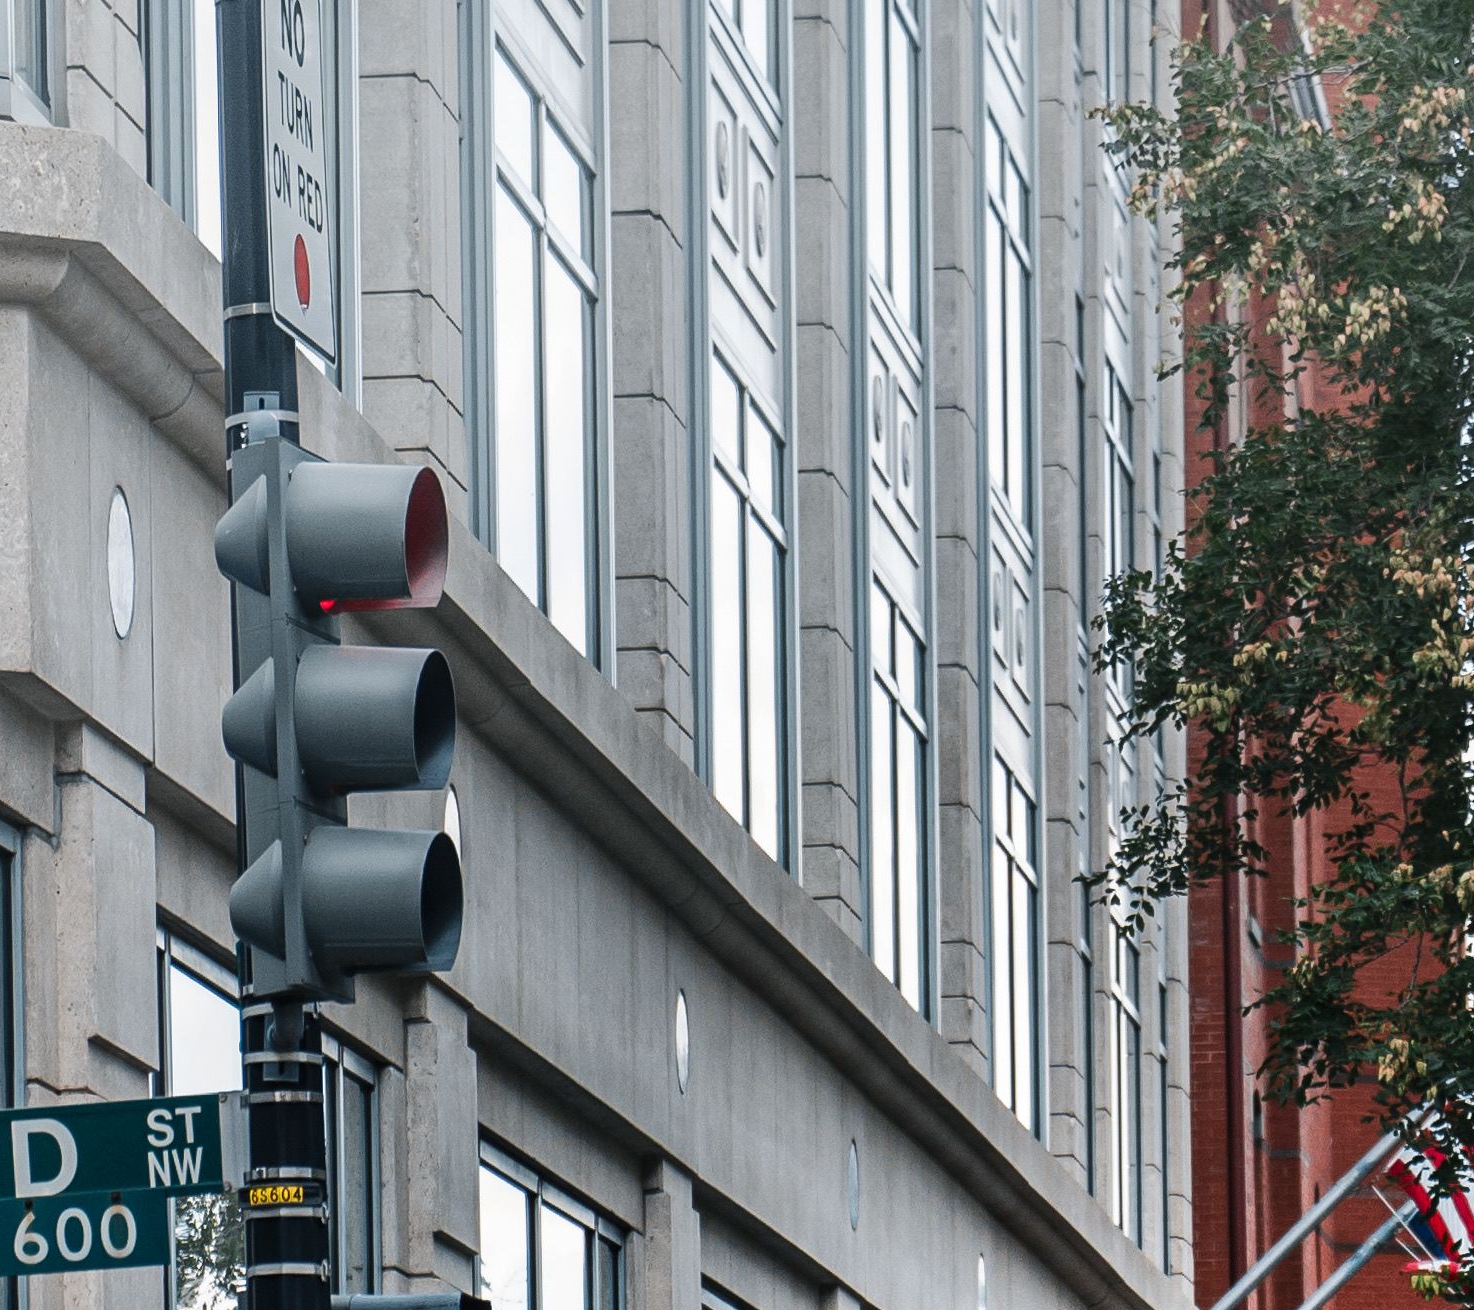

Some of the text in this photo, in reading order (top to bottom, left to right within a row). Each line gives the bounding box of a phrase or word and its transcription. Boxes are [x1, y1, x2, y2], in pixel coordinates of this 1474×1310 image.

[281, 0, 305, 67] NO
[278, 70, 313, 152] TURN
[274, 143, 323, 234] ON RED
[11, 1118, 78, 1199] D
[147, 1106, 202, 1147] ST
[148, 1147, 203, 1188] NW
[14, 1204, 137, 1265] 600
